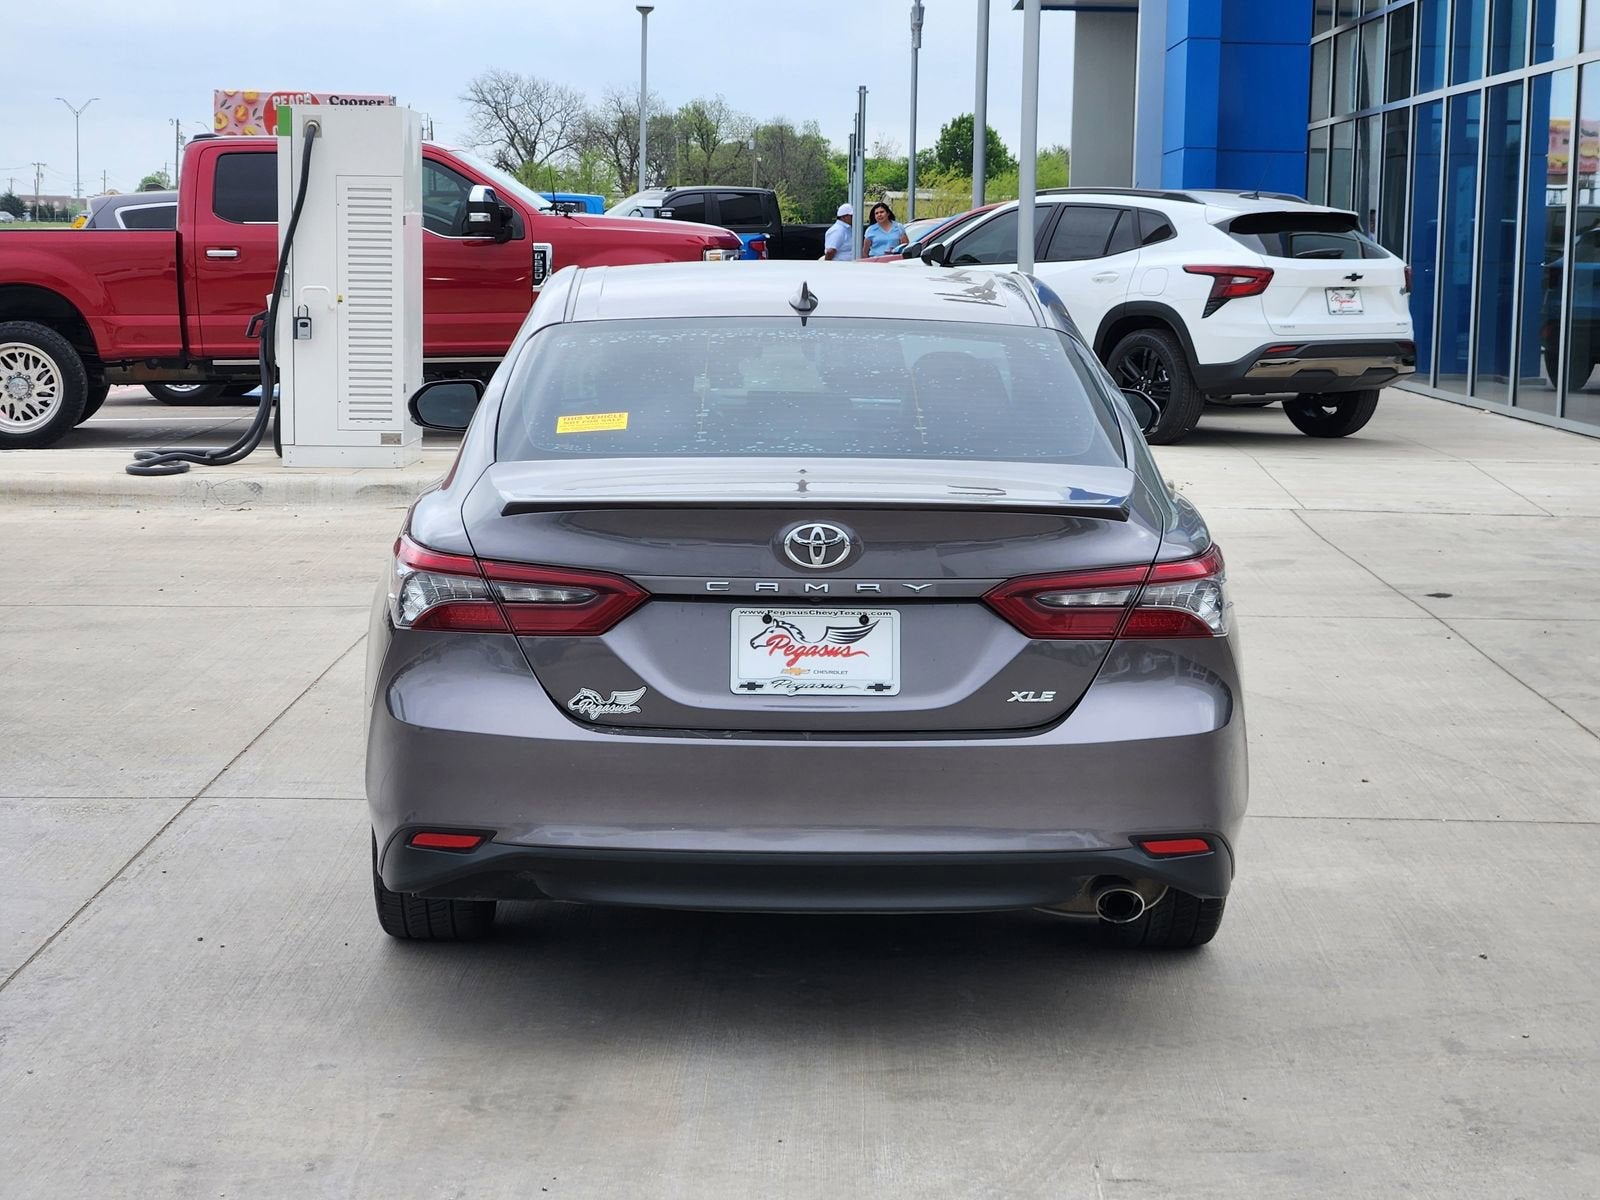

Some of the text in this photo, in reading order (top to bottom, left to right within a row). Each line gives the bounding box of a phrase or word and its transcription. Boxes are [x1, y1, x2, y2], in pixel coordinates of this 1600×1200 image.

[329, 95, 385, 106] Cooper
[705, 581, 933, 593] CAMRY
[766, 633, 870, 668] Pegasus
[770, 679, 861, 693] Pegasus
[1006, 691, 1057, 702] XLE
[578, 698, 641, 720] Pegasus
